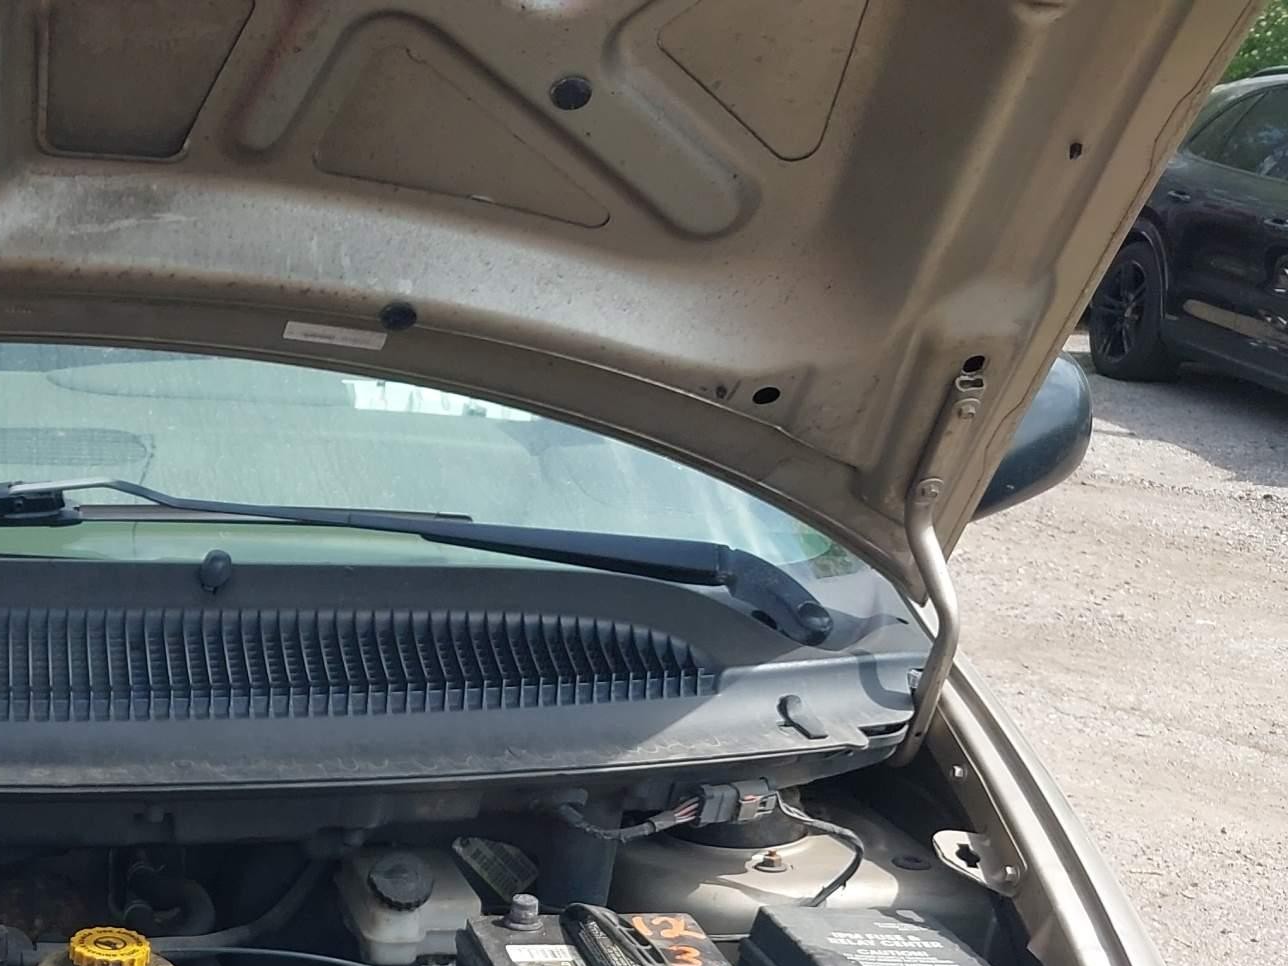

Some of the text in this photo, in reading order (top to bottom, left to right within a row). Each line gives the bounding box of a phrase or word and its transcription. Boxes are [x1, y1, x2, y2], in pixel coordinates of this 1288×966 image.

[865, 933, 905, 942] FUSE
[826, 937, 944, 949] RELAY CENTER
